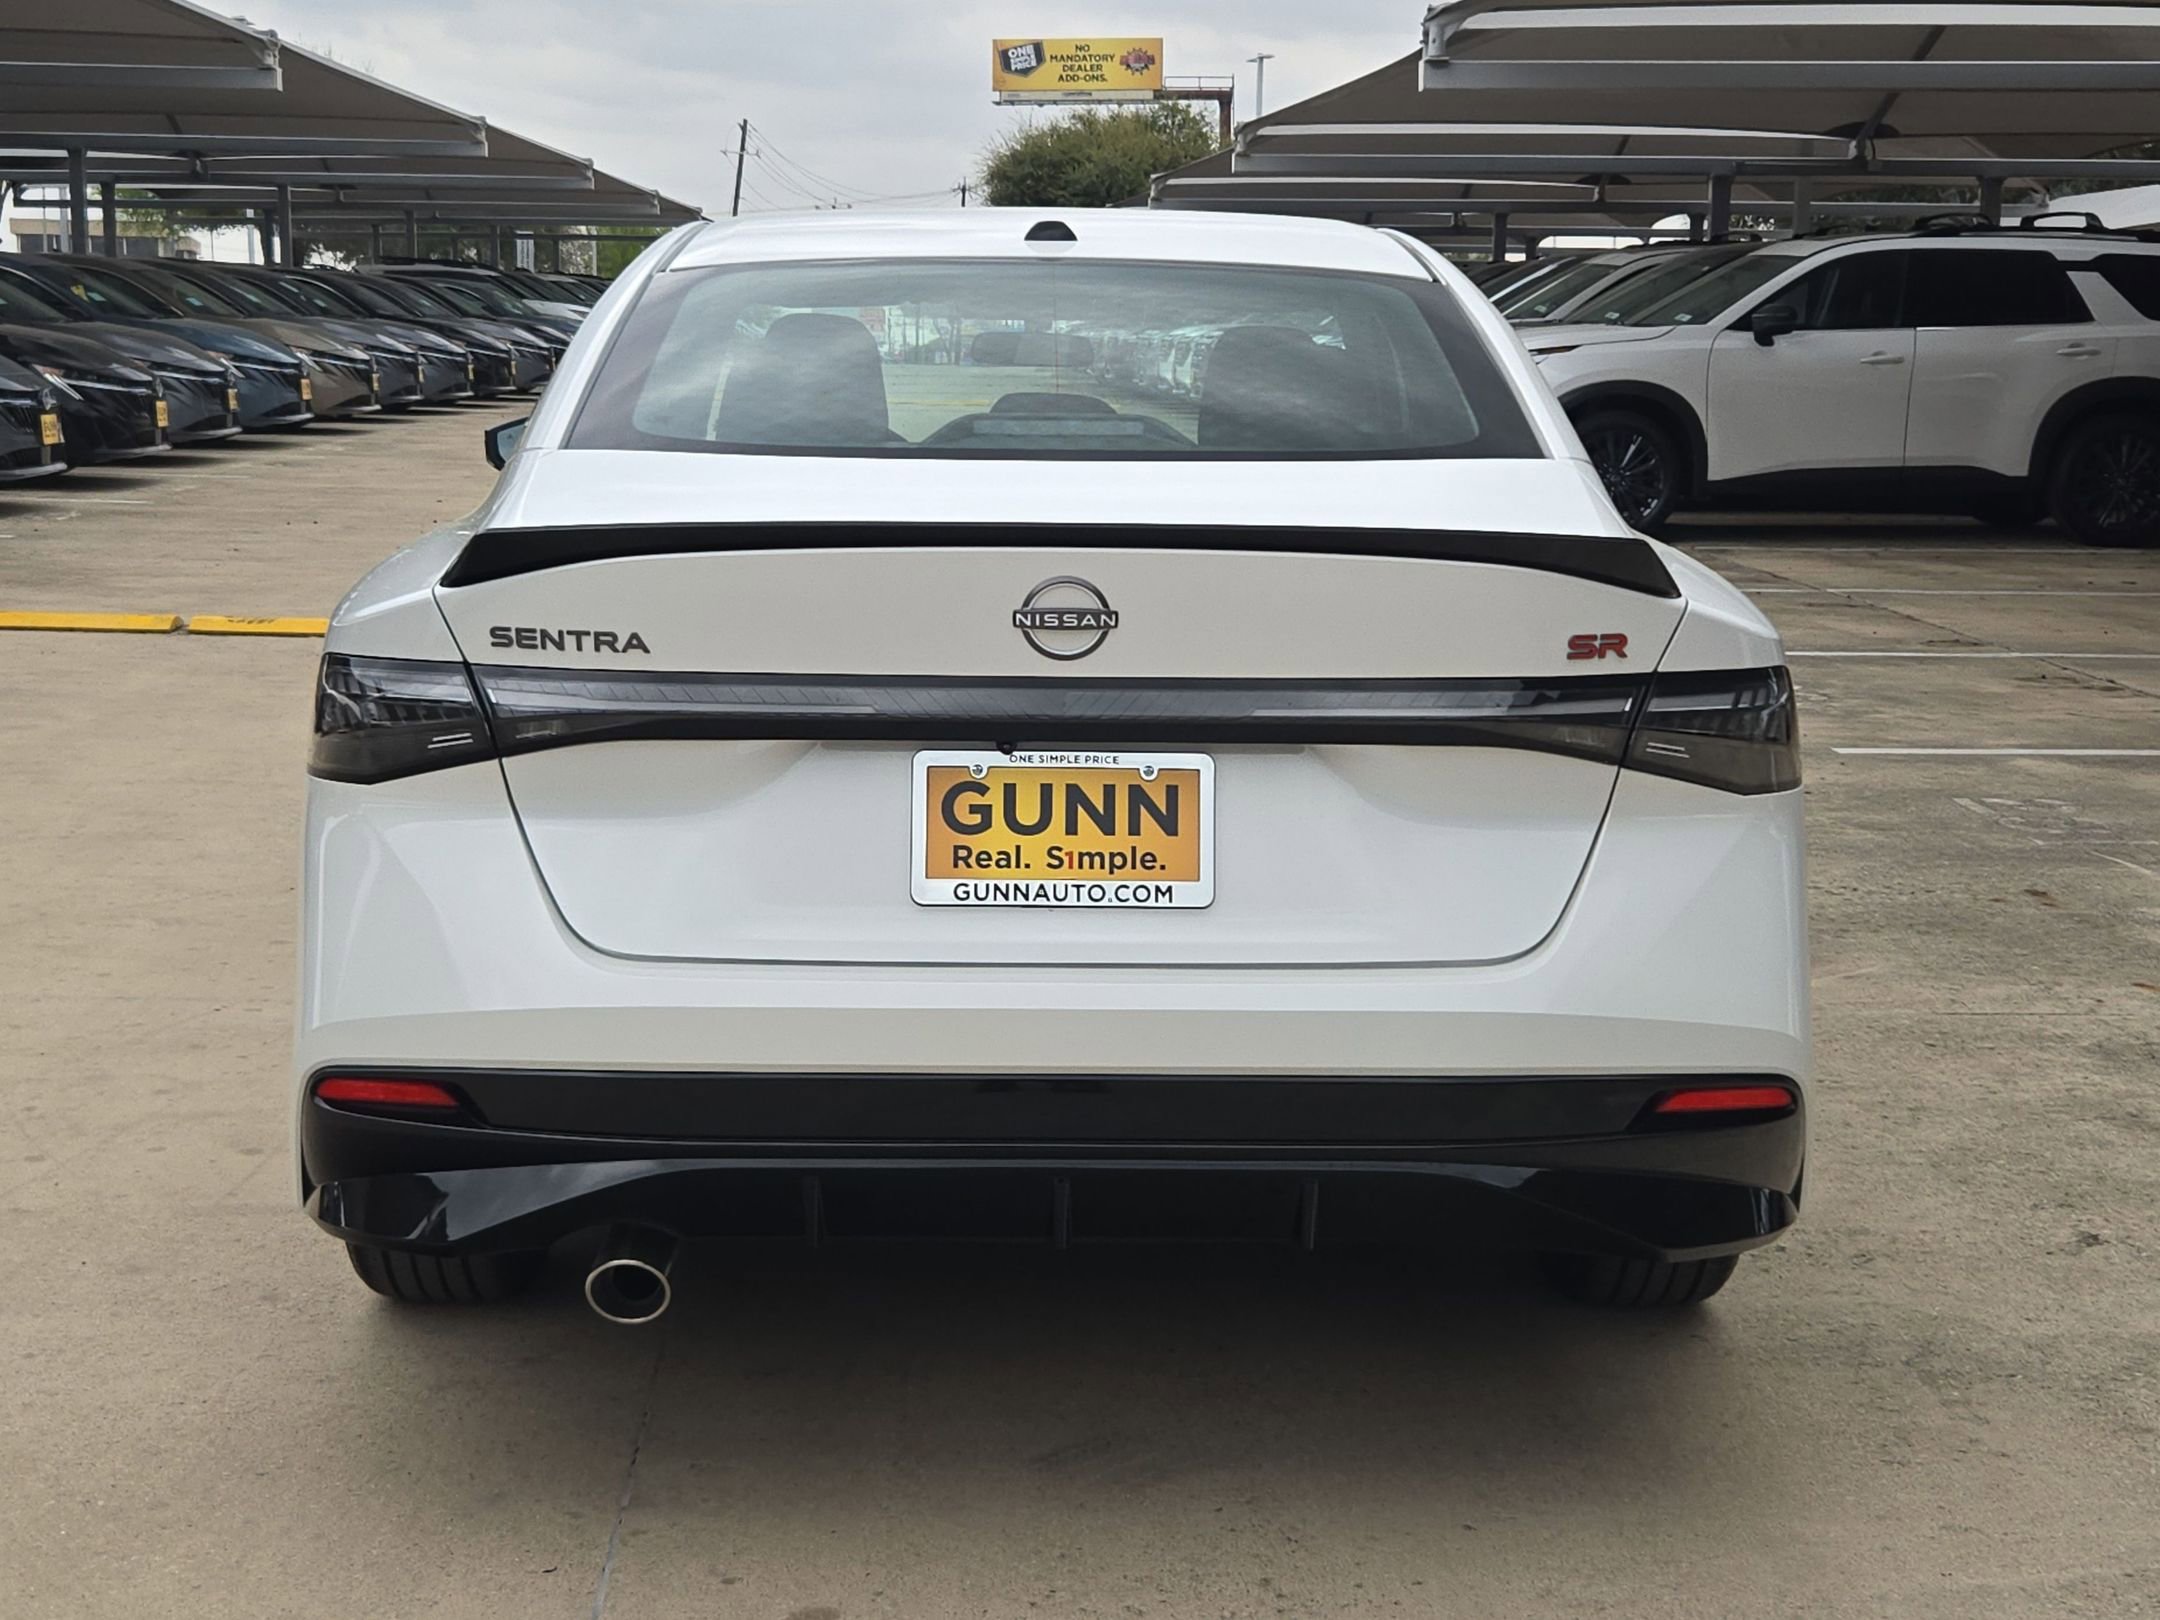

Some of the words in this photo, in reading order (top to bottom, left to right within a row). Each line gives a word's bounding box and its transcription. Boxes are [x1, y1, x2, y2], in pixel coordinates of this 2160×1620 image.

[1008, 45, 1034, 58] ONE
[1075, 44, 1090, 52] NO
[1050, 54, 1115, 62] MANDATORY
[1062, 64, 1103, 72] DEALER
[1058, 74, 1108, 82] ADD-ONS.
[1015, 613, 1116, 627] NISSAN
[489, 626, 651, 654] SENTRA
[1566, 633, 1628, 660] SR
[1009, 754, 1034, 763] ONE
[1038, 754, 1081, 764] SIMPLE
[1084, 755, 1119, 765] PRICE
[941, 780, 1179, 837] GUNN
[952, 845, 1030, 870] Real.
[953, 883, 1173, 904] GUNNAUTO.COM
